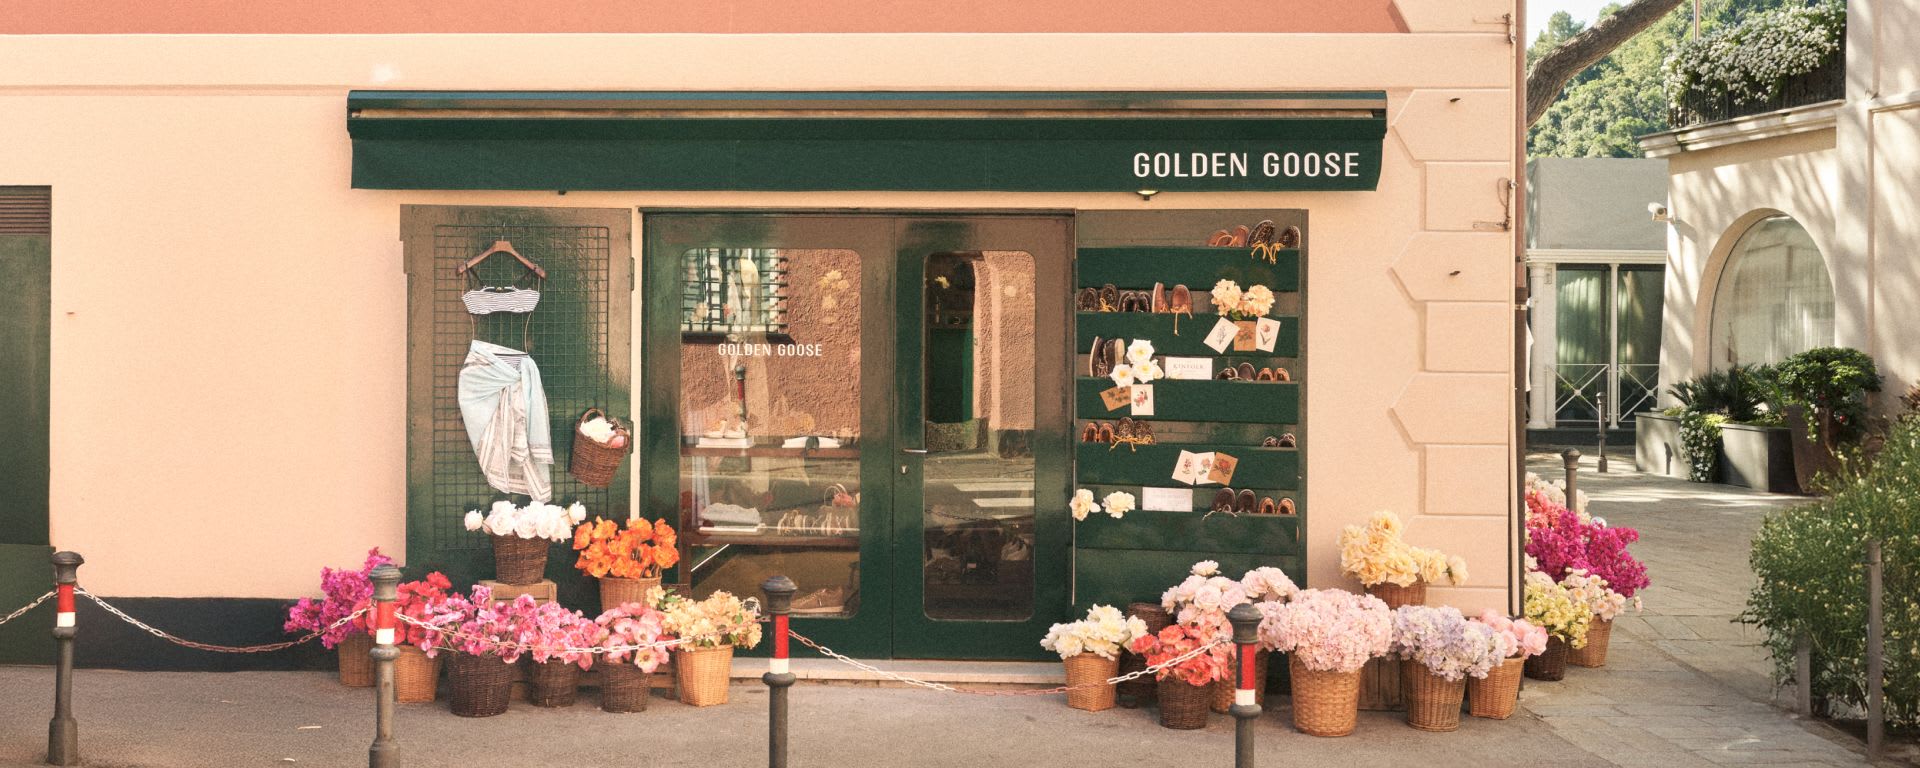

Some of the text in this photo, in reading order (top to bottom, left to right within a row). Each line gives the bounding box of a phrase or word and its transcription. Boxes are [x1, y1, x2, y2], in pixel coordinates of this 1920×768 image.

[1133, 152, 1360, 177] GOLDEN GOOSE
[718, 343, 823, 356] GOLDEN GOOSE
